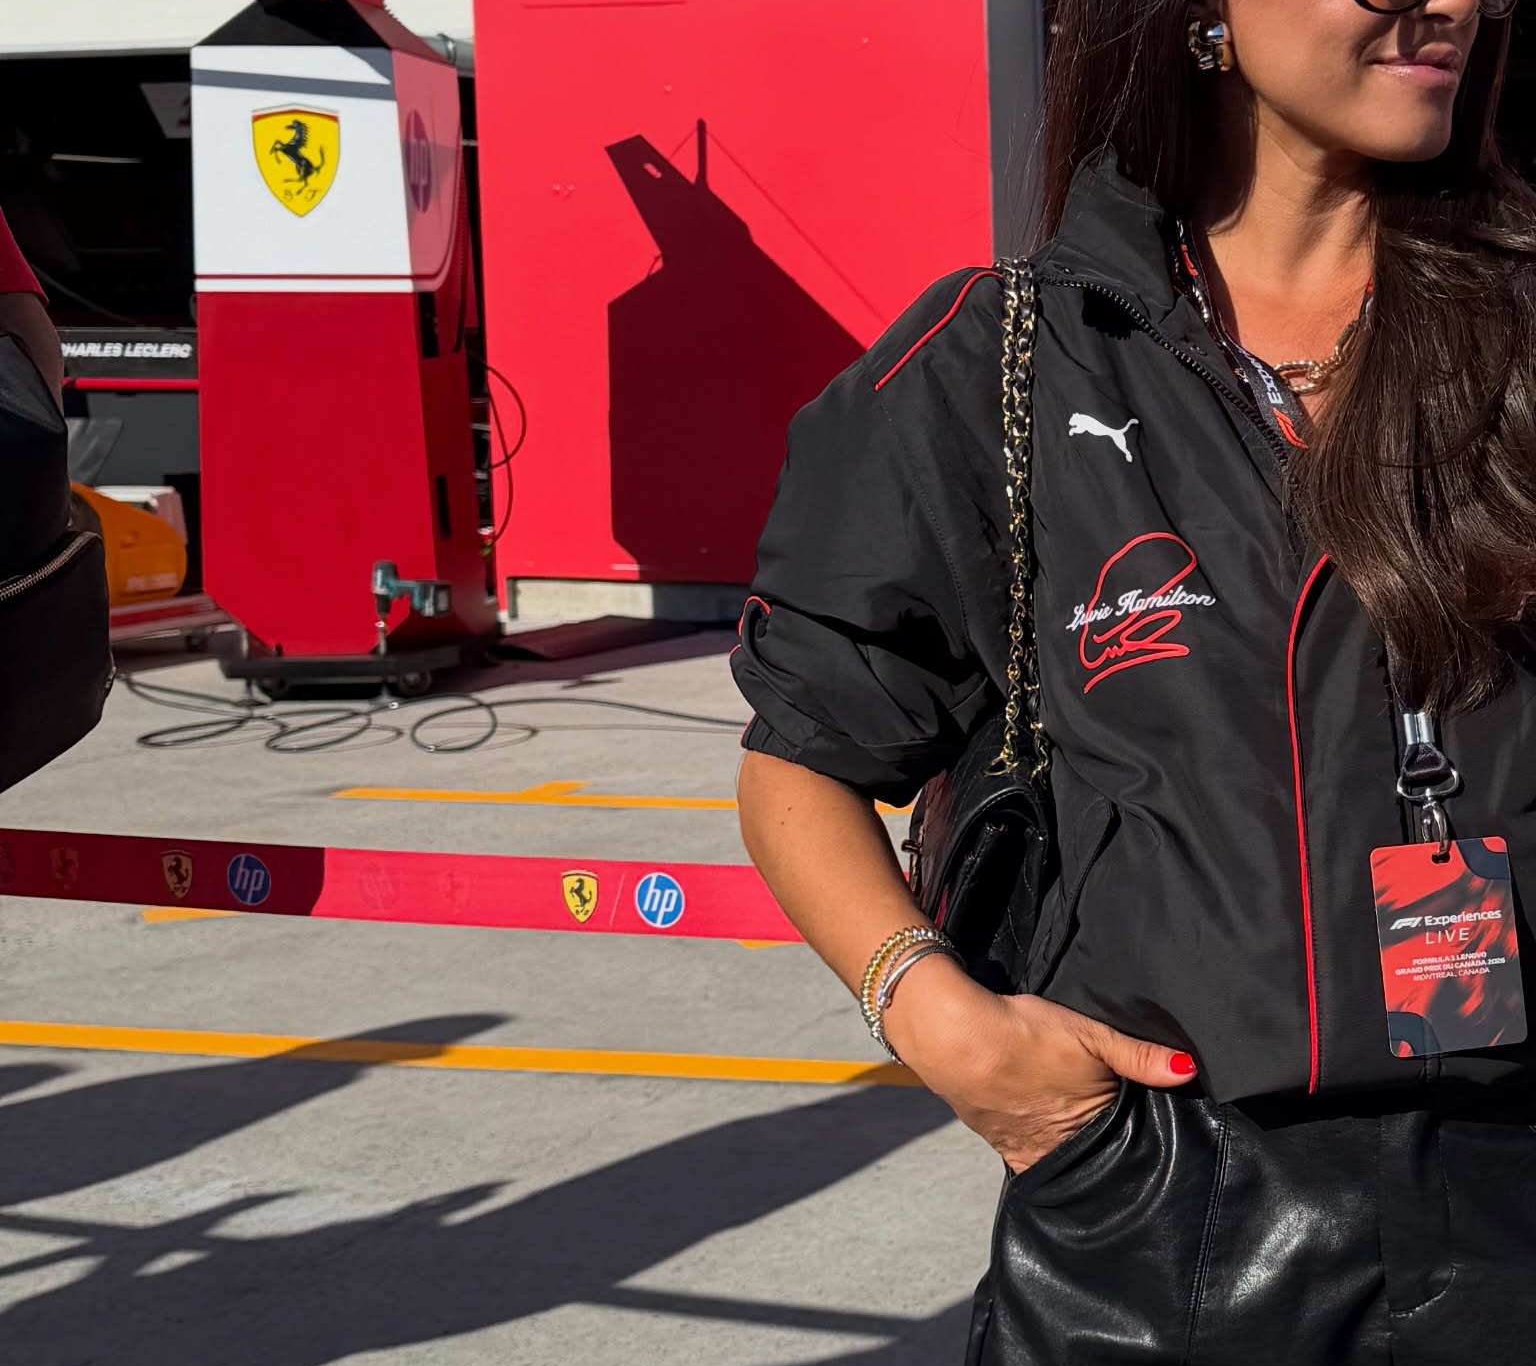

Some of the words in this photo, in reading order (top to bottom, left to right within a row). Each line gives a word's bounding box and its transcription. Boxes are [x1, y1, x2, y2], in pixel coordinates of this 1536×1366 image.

[1065, 602, 1114, 632] Lewis
[1115, 584, 1217, 617] Hamilton
[233, 854, 266, 905] hp
[641, 874, 680, 927] hp
[1424, 909, 1502, 927] Experiences
[1425, 927, 1471, 945] LIVE
[1395, 965, 1424, 976] GRAND
[1424, 963, 1442, 973] PRIX
[1442, 962, 1453, 970] DU
[1454, 959, 1487, 969] CANADA
[1412, 955, 1450, 966] FORMULA
[1458, 966, 1491, 977] CANADA
